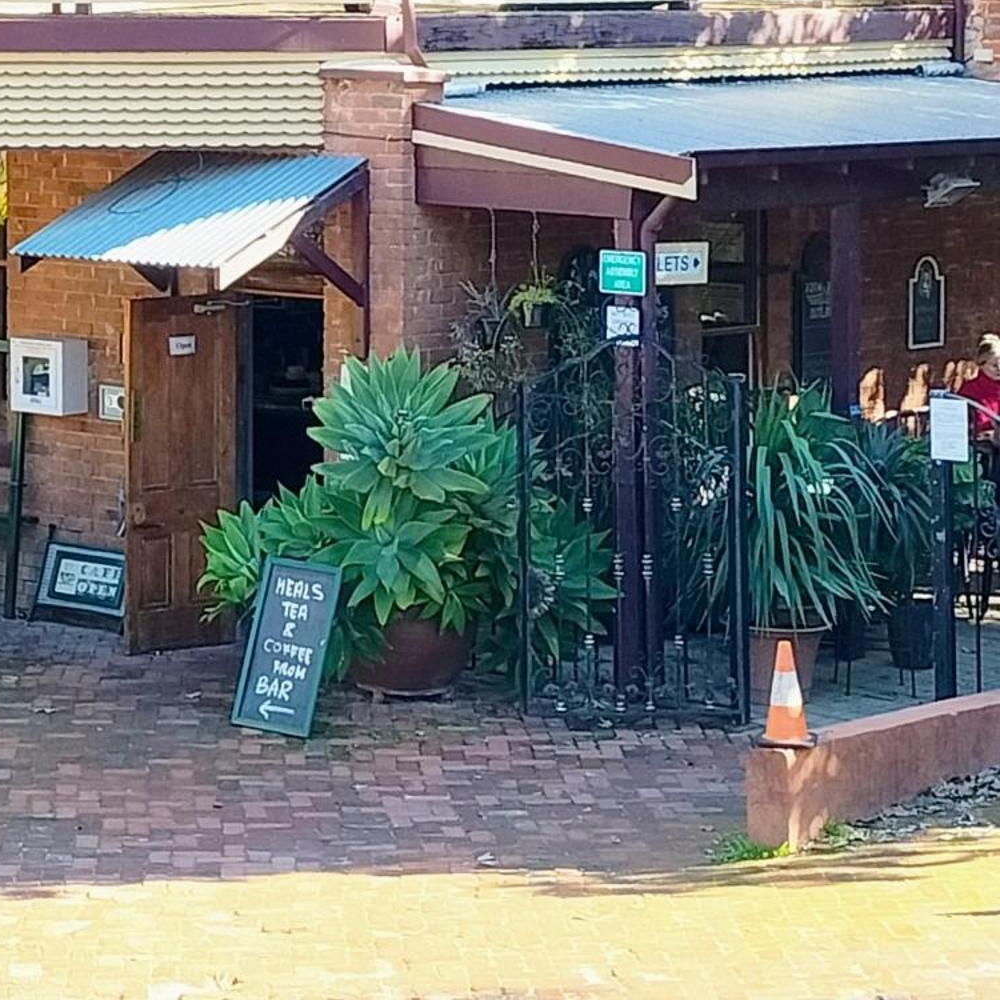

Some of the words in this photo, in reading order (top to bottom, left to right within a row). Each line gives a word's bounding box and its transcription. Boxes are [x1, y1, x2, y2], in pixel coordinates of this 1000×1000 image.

[657, 255, 689, 271] LETS
[613, 280, 631, 290] AREA
[77, 582, 117, 598] OPEN
[282, 601, 308, 621] TEA
[283, 622, 296, 638] &
[264, 638, 312, 666] COFFEE
[273, 660, 306, 680] FROM
[256, 675, 293, 702] BAR
